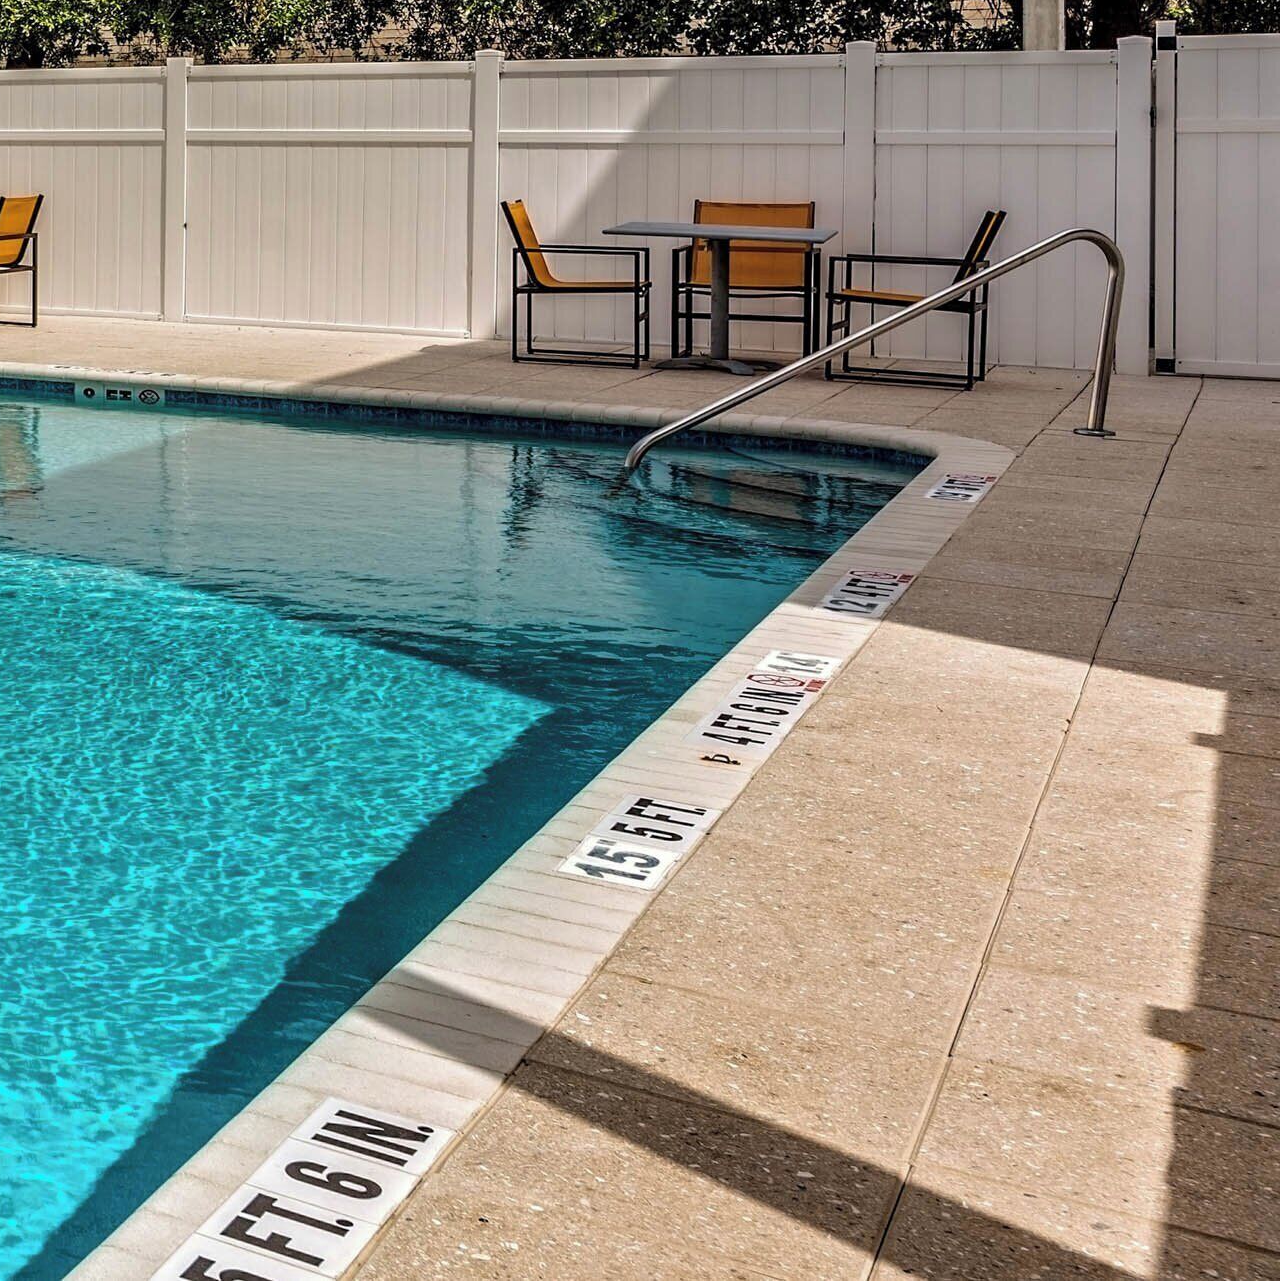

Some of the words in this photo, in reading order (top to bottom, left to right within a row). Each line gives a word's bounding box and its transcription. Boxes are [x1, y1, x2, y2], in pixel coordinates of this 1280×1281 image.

[739, 687, 806, 706] IN.
[730, 703, 789, 716] 6
[710, 714, 780, 736] FT.
[702, 732, 766, 746] 4
[625, 798, 707, 827] FT.
[610, 822, 683, 842] 5
[311, 1110, 435, 1167] IN.
[284, 1160, 383, 1200] 6
[219, 1193, 354, 1268] FT.
